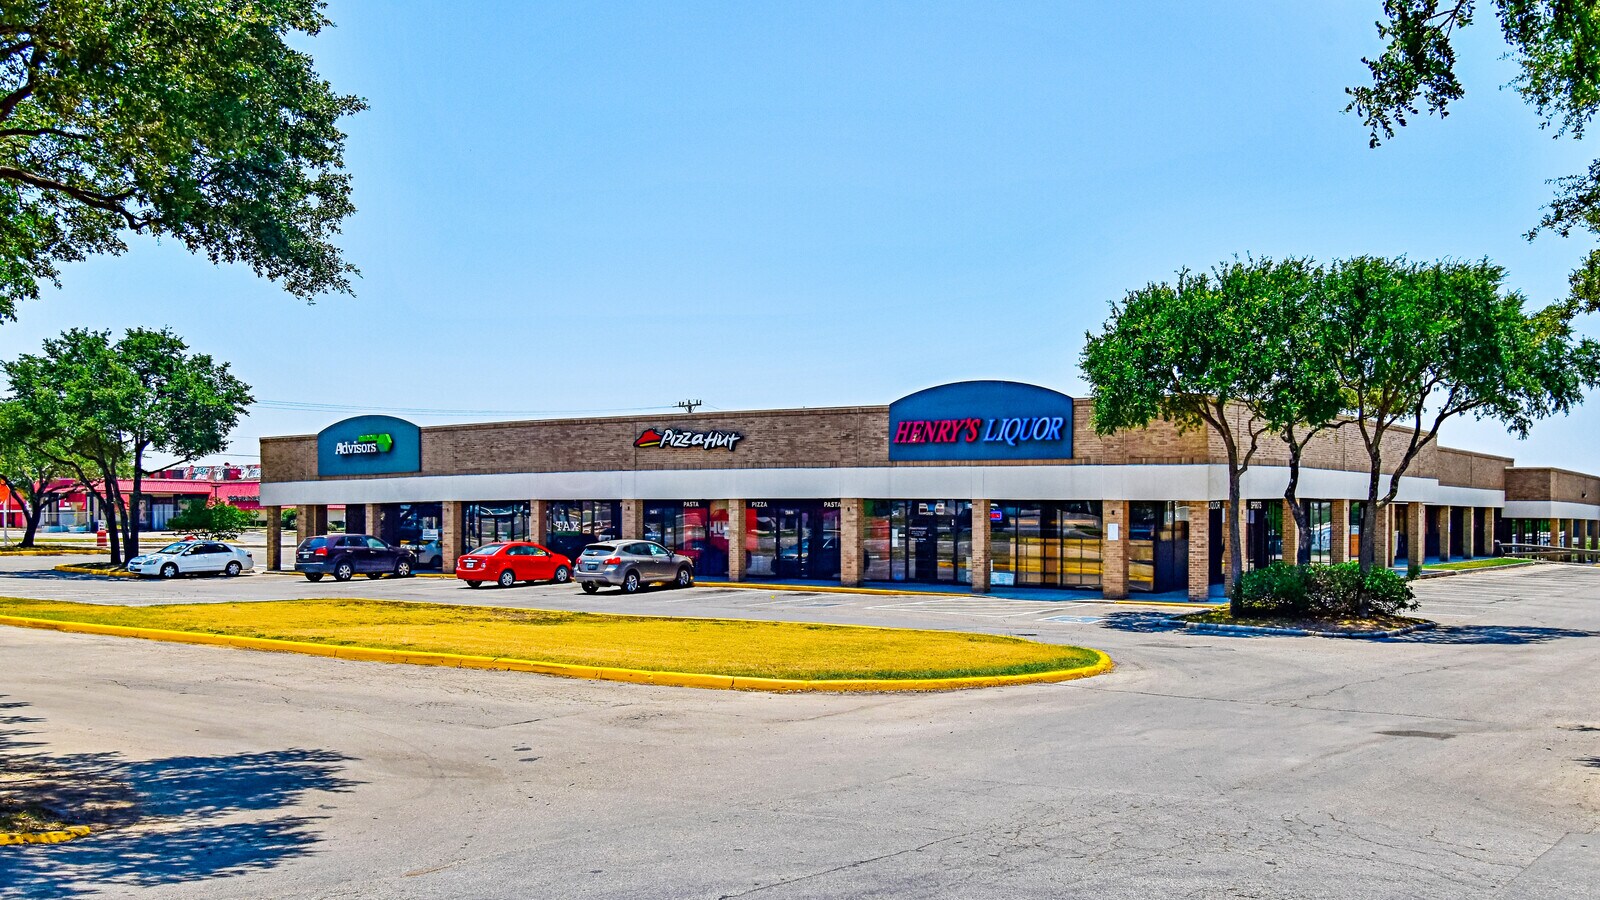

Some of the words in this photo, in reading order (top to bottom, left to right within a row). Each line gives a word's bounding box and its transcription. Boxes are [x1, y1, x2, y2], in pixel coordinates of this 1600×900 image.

[893, 418, 981, 444] HENRY'S
[983, 417, 1064, 446] LIQUOR
[659, 429, 704, 448] Pizza
[703, 431, 741, 451] Hut
[335, 441, 377, 455] Advisors
[1209, 501, 1221, 510] IQUOR
[555, 521, 580, 532] TAX
